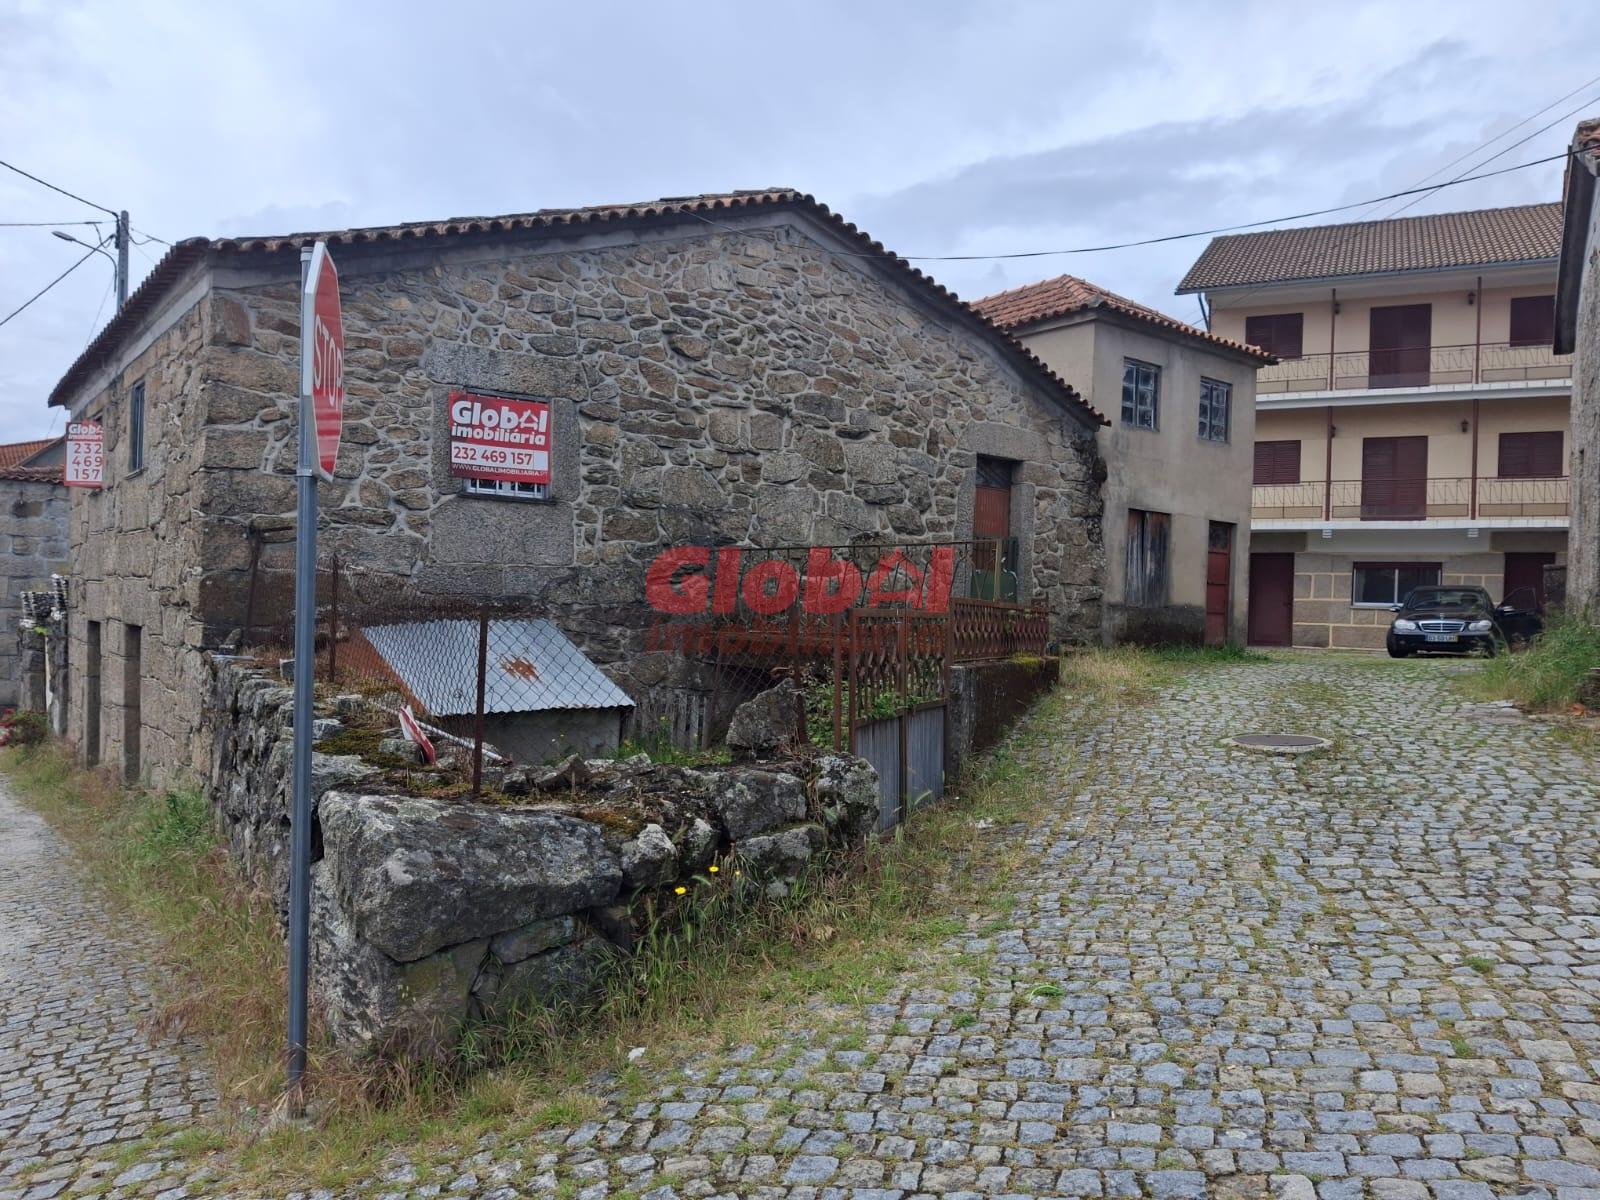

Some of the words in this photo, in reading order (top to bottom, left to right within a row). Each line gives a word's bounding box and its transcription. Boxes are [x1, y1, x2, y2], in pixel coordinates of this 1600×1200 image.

[314, 313, 342, 412] STOP
[451, 400, 548, 433] Global
[451, 423, 545, 445] imobiliária
[74, 443, 102, 454] 232
[454, 447, 477, 460] 232
[481, 450, 507, 463] 469
[511, 452, 532, 465] 157
[72, 456, 103, 467] 469
[74, 469, 100, 480] 157
